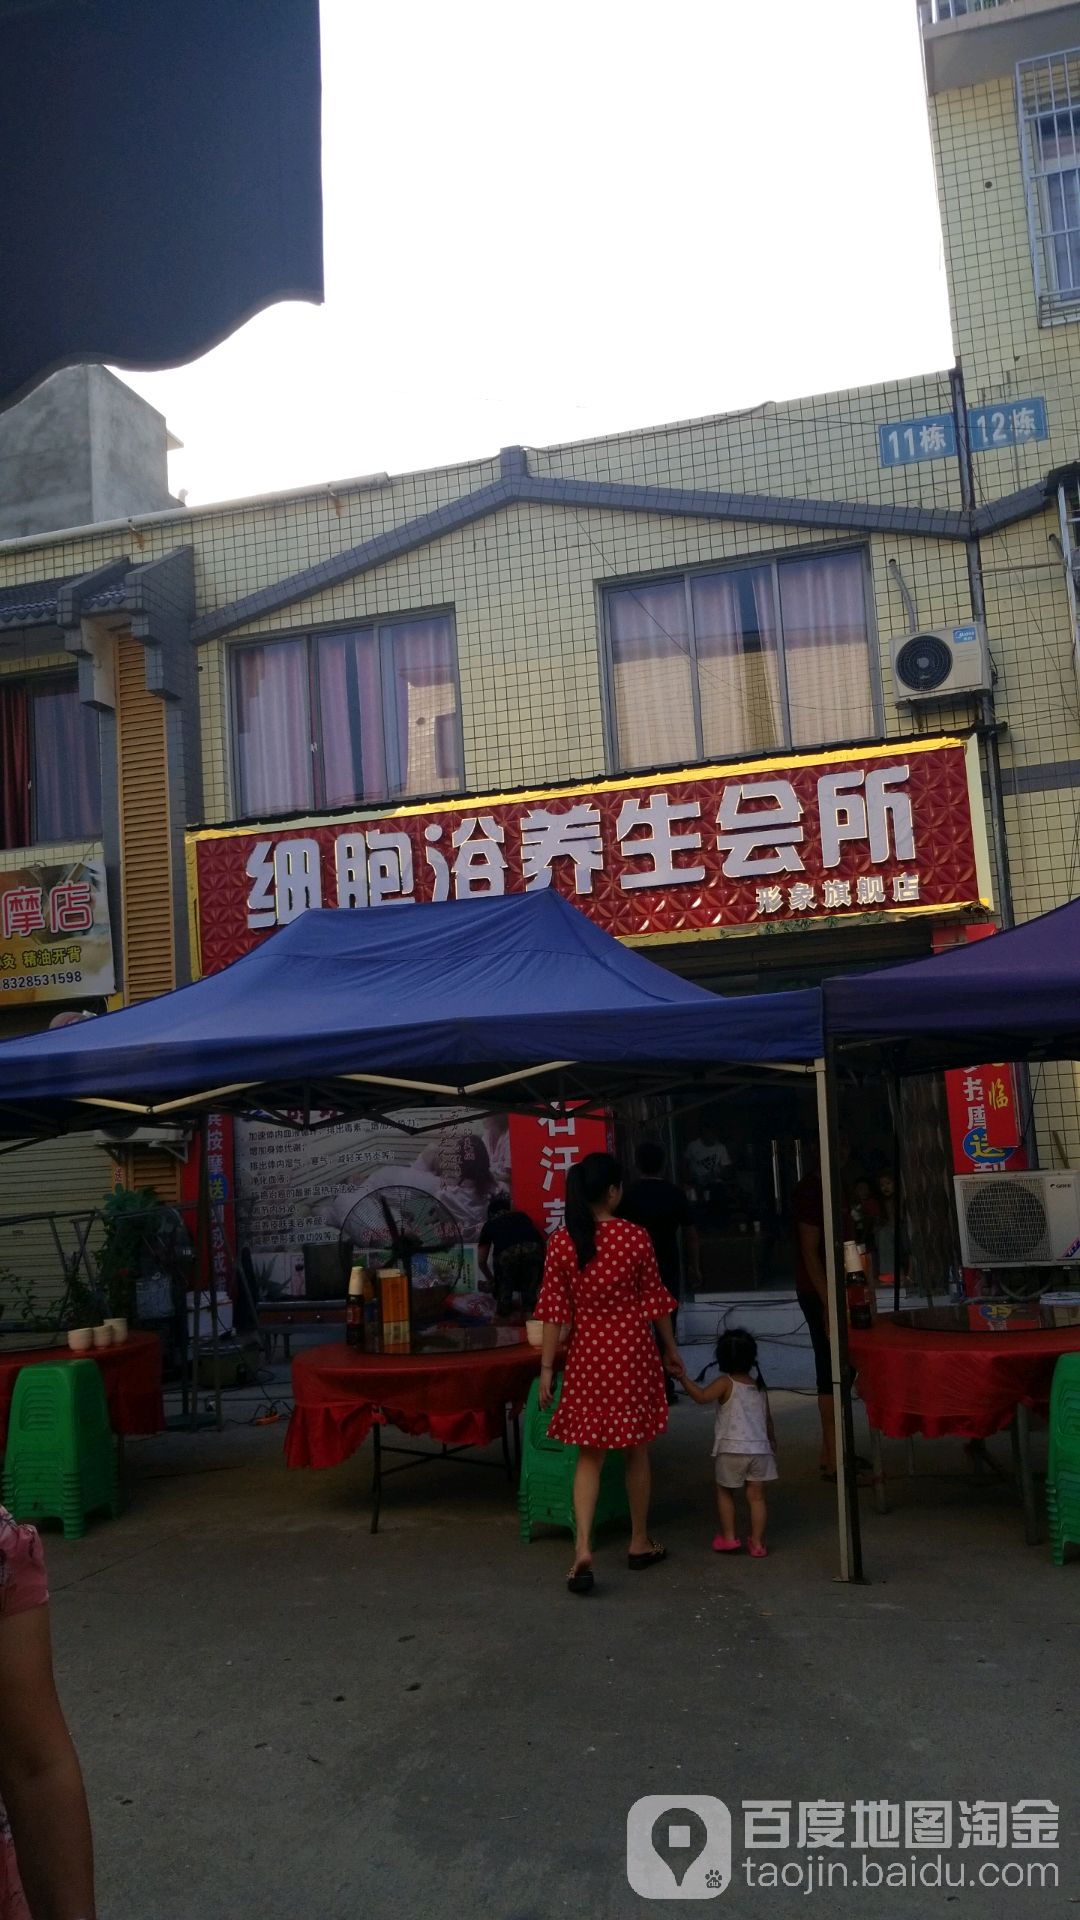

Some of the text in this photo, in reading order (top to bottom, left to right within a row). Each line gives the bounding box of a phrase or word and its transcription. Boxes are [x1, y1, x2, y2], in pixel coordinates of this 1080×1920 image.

[888, 423, 946, 459] 11栋
[977, 407, 1036, 443] 12栋
[246, 765, 916, 929] 细胞浴养生会所
[3, 881, 93, 939] 摩店
[755, 872, 920, 914] 形象旗舰店
[22, 945, 82, 968] 精油开背
